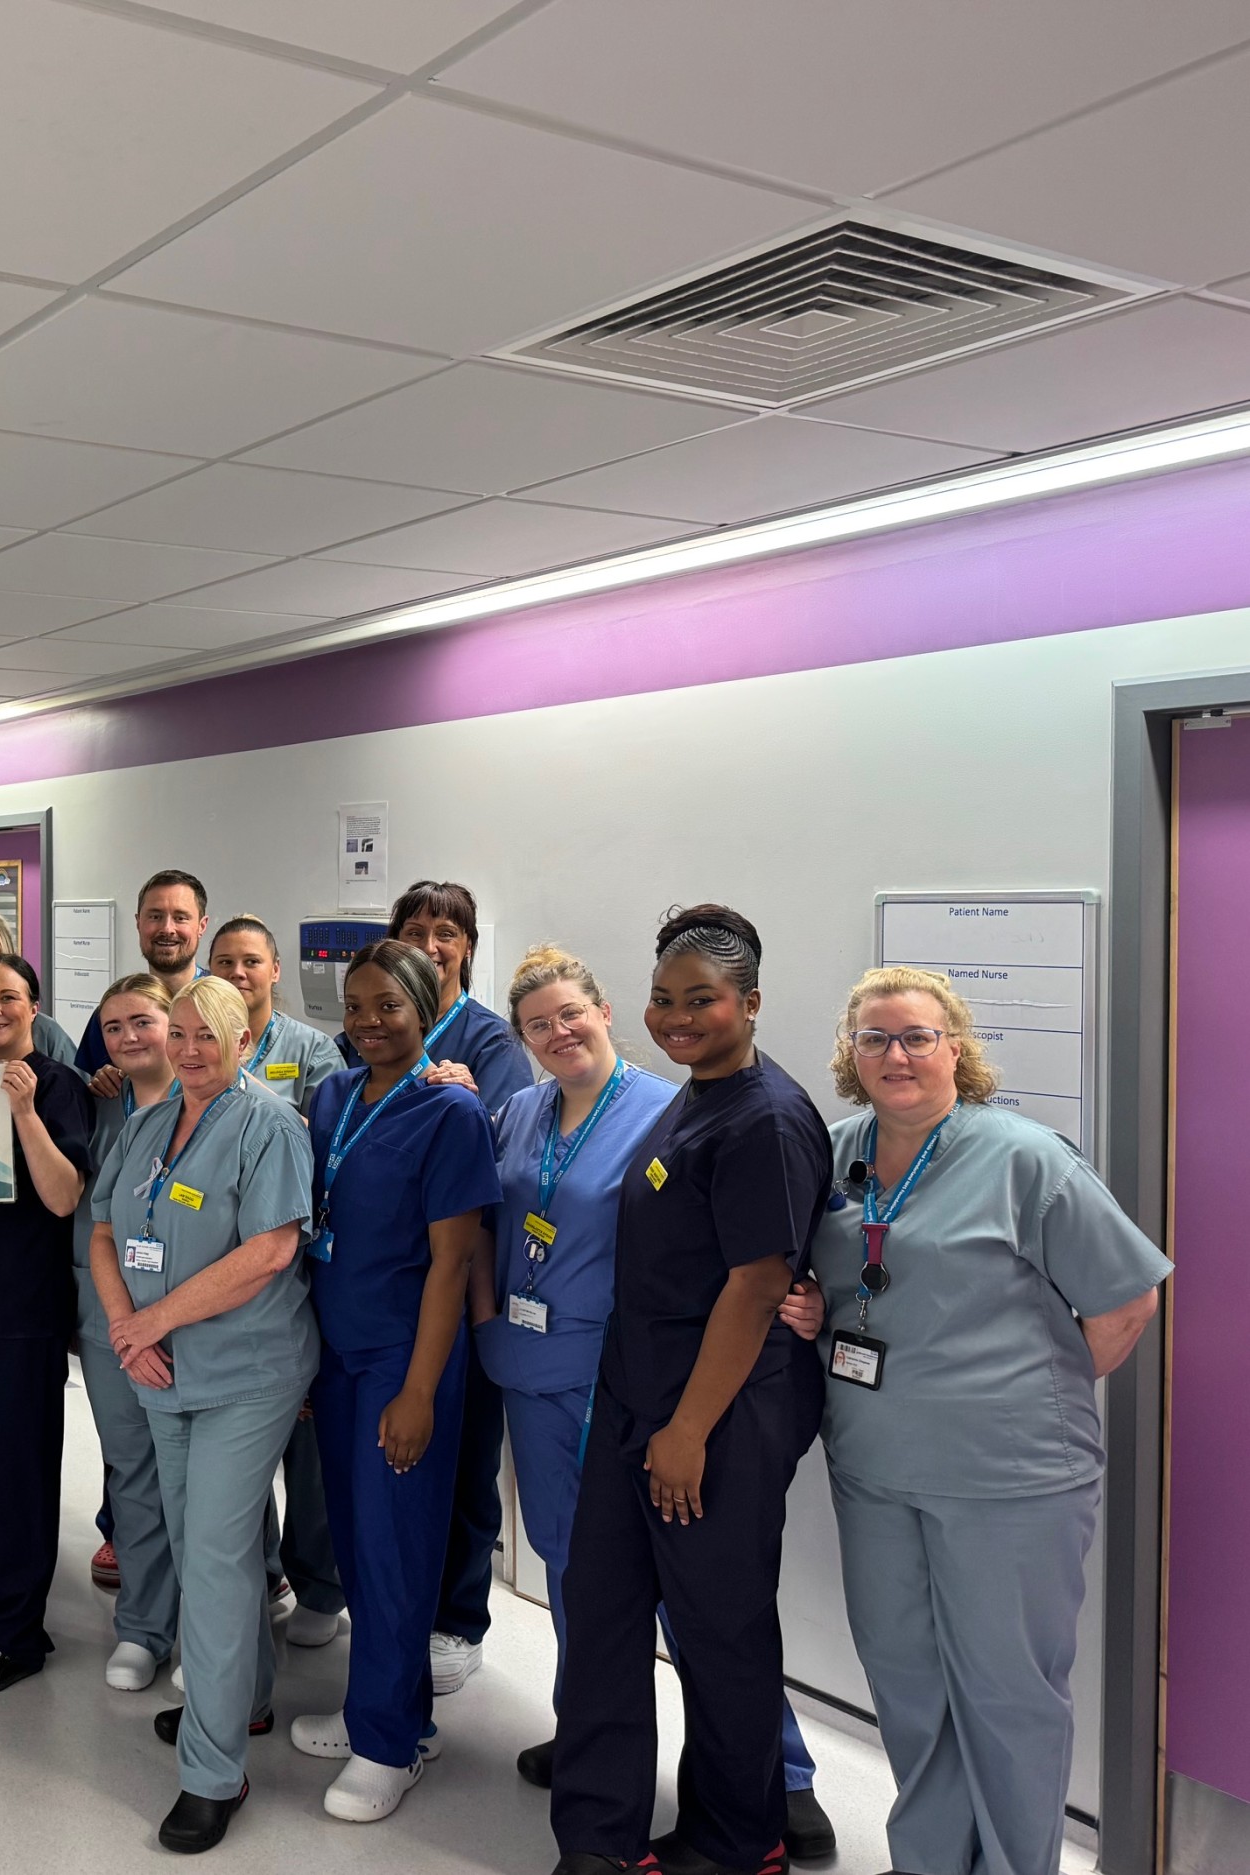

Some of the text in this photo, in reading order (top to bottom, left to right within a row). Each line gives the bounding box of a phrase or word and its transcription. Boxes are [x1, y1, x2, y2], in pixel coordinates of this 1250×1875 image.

[949, 907, 1009, 916] Patient Name
[948, 968, 1008, 980] Named Nurse
[973, 1032, 1004, 1041] scopist
[987, 1096, 1020, 1106] uctions
[908, 1158, 923, 1181] Sunderland
[889, 1189, 904, 1212] Foundation
